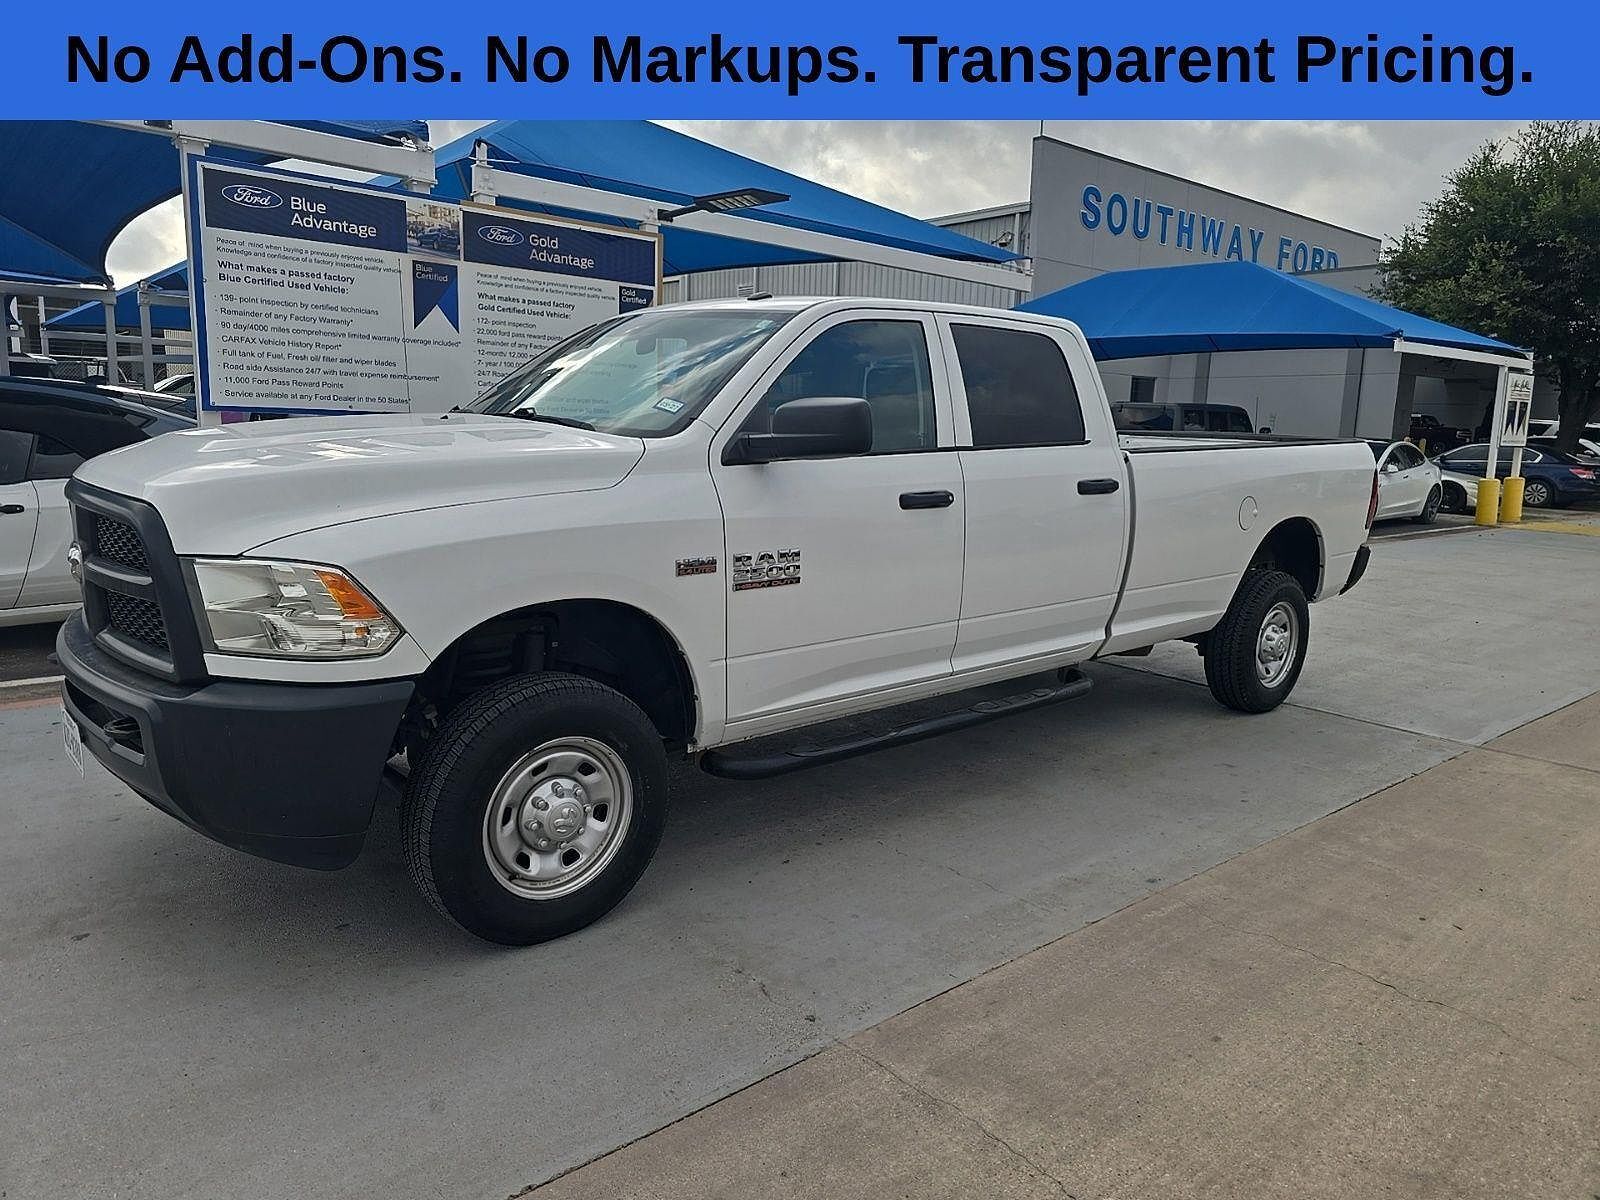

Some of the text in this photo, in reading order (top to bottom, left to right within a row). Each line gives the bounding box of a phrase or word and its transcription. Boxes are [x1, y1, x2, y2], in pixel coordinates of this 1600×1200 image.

[233, 186, 272, 206] Ford
[290, 196, 326, 214] Blue
[291, 213, 377, 238] Advantage
[1080, 184, 1339, 273] SOUTHWAY FORD
[487, 227, 515, 243] Ford
[529, 234, 558, 249] Gold
[216, 237, 236, 245] Peace
[310, 250, 339, 259] previously
[216, 246, 252, 256] Knowledge
[267, 253, 300, 262] confidence
[415, 263, 433, 272] Blue
[529, 249, 594, 269] Advantage
[217, 260, 243, 270] What
[246, 265, 277, 274] makes
[289, 270, 321, 279] passed
[324, 272, 355, 284] factory
[415, 272, 448, 282] Certified
[218, 273, 349, 294] Blue Certified Used Vehicle:
[260, 298, 298, 307] inspection
[300, 302, 308, 310] by
[311, 303, 338, 312] certified
[340, 306, 379, 315] technicians
[477, 292, 496, 300] What
[553, 300, 575, 310] factory
[621, 296, 647, 305] Certified
[220, 308, 262, 317] Remainder
[290, 314, 317, 324] Factory
[496, 306, 526, 314] Certified
[546, 311, 571, 319] Vehicle:
[221, 335, 257, 344] CARFAX
[259, 338, 286, 346] Vehicle
[288, 340, 313, 349] History
[233, 323, 268, 332] day/4000
[292, 329, 346, 338] comprehensive
[402, 337, 431, 346] coverage
[263, 365, 304, 374] Assistance
[374, 359, 396, 367] blades
[733, 549, 800, 567] RAM
[733, 563, 800, 582] 2500
